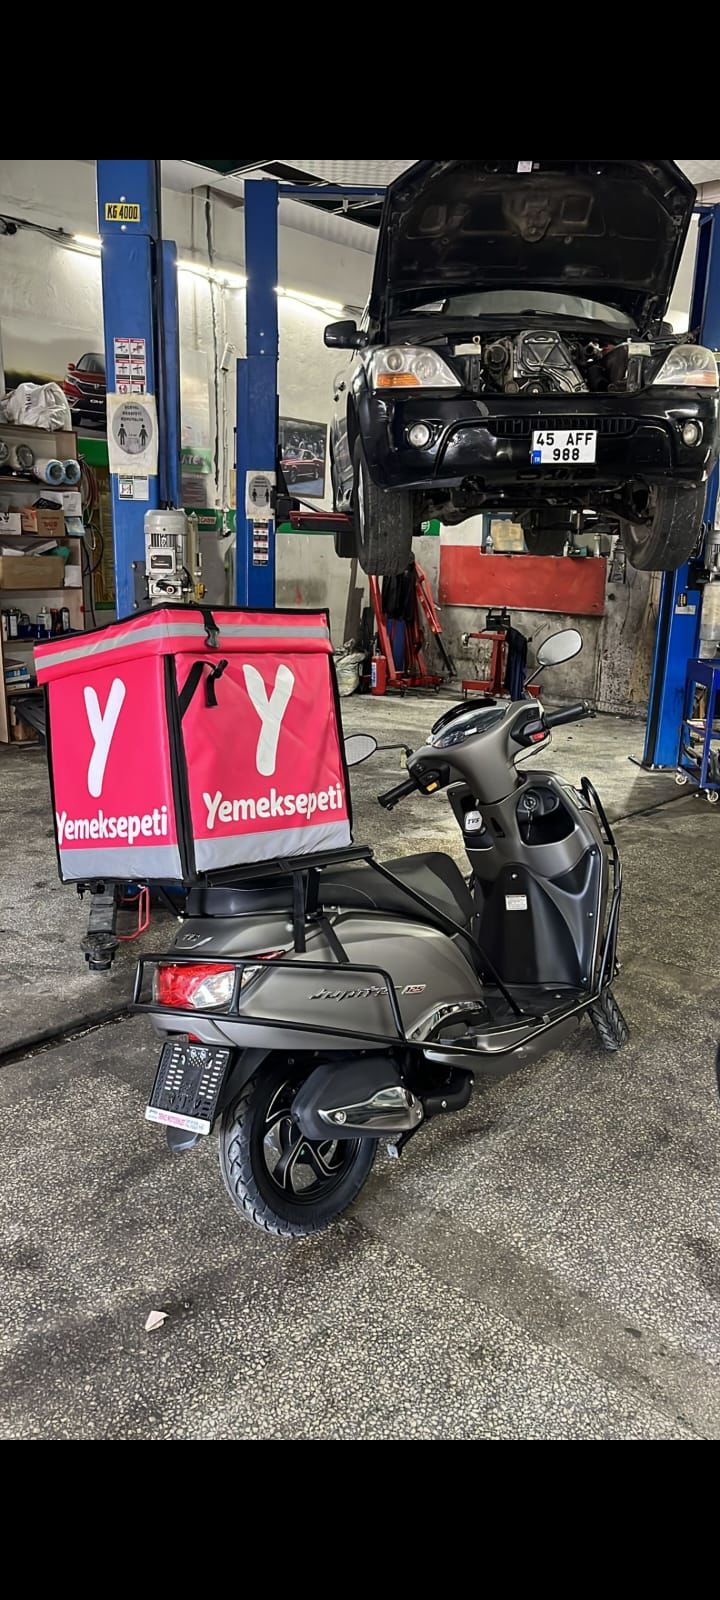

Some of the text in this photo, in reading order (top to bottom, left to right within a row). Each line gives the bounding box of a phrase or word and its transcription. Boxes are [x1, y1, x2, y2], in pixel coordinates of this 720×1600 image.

[107, 204, 138, 220] KG 4000
[536, 432, 594, 446] 45 AFF
[552, 447, 580, 462] 988
[83, 677, 126, 798] Y
[243, 664, 295, 777] Y
[55, 805, 168, 845] Yemeksepeti
[202, 782, 343, 830] Yemeksepeti
